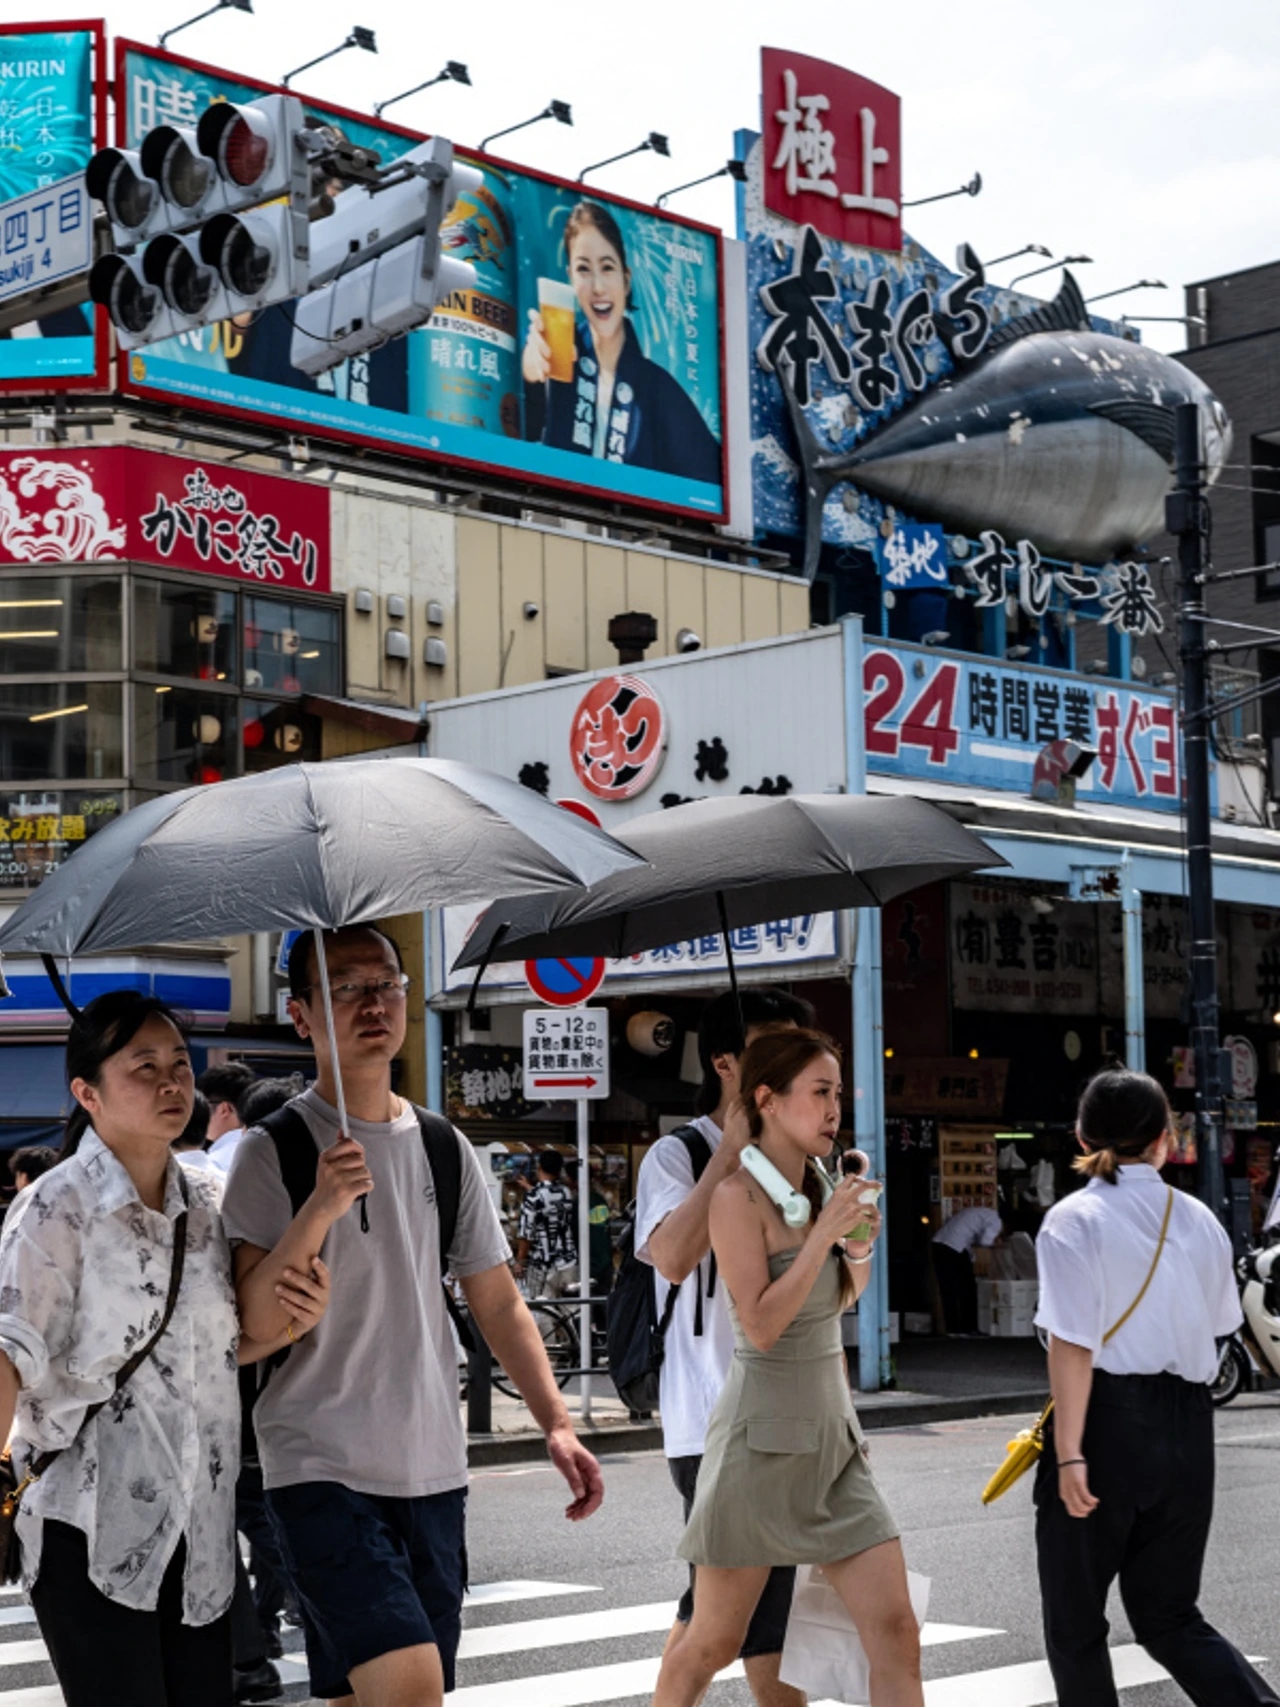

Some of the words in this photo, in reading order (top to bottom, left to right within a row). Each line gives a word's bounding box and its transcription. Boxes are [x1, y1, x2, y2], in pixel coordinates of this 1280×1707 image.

[1, 60, 66, 78] KIRIN
[773, 68, 900, 219] 極上
[40, 248, 52, 268] 4
[665, 240, 704, 266] KIRIN
[758, 222, 991, 410] 本まぐろ
[431, 337, 501, 382] 晴れ風
[183, 467, 246, 515] 築地
[140, 491, 318, 587] かに祭り
[882, 527, 949, 588] 築地
[962, 527, 1166, 638] すし一番
[1095, 690, 1187, 802] すぐヨ
[528, 1052, 604, 1070] 貨物車を除く
